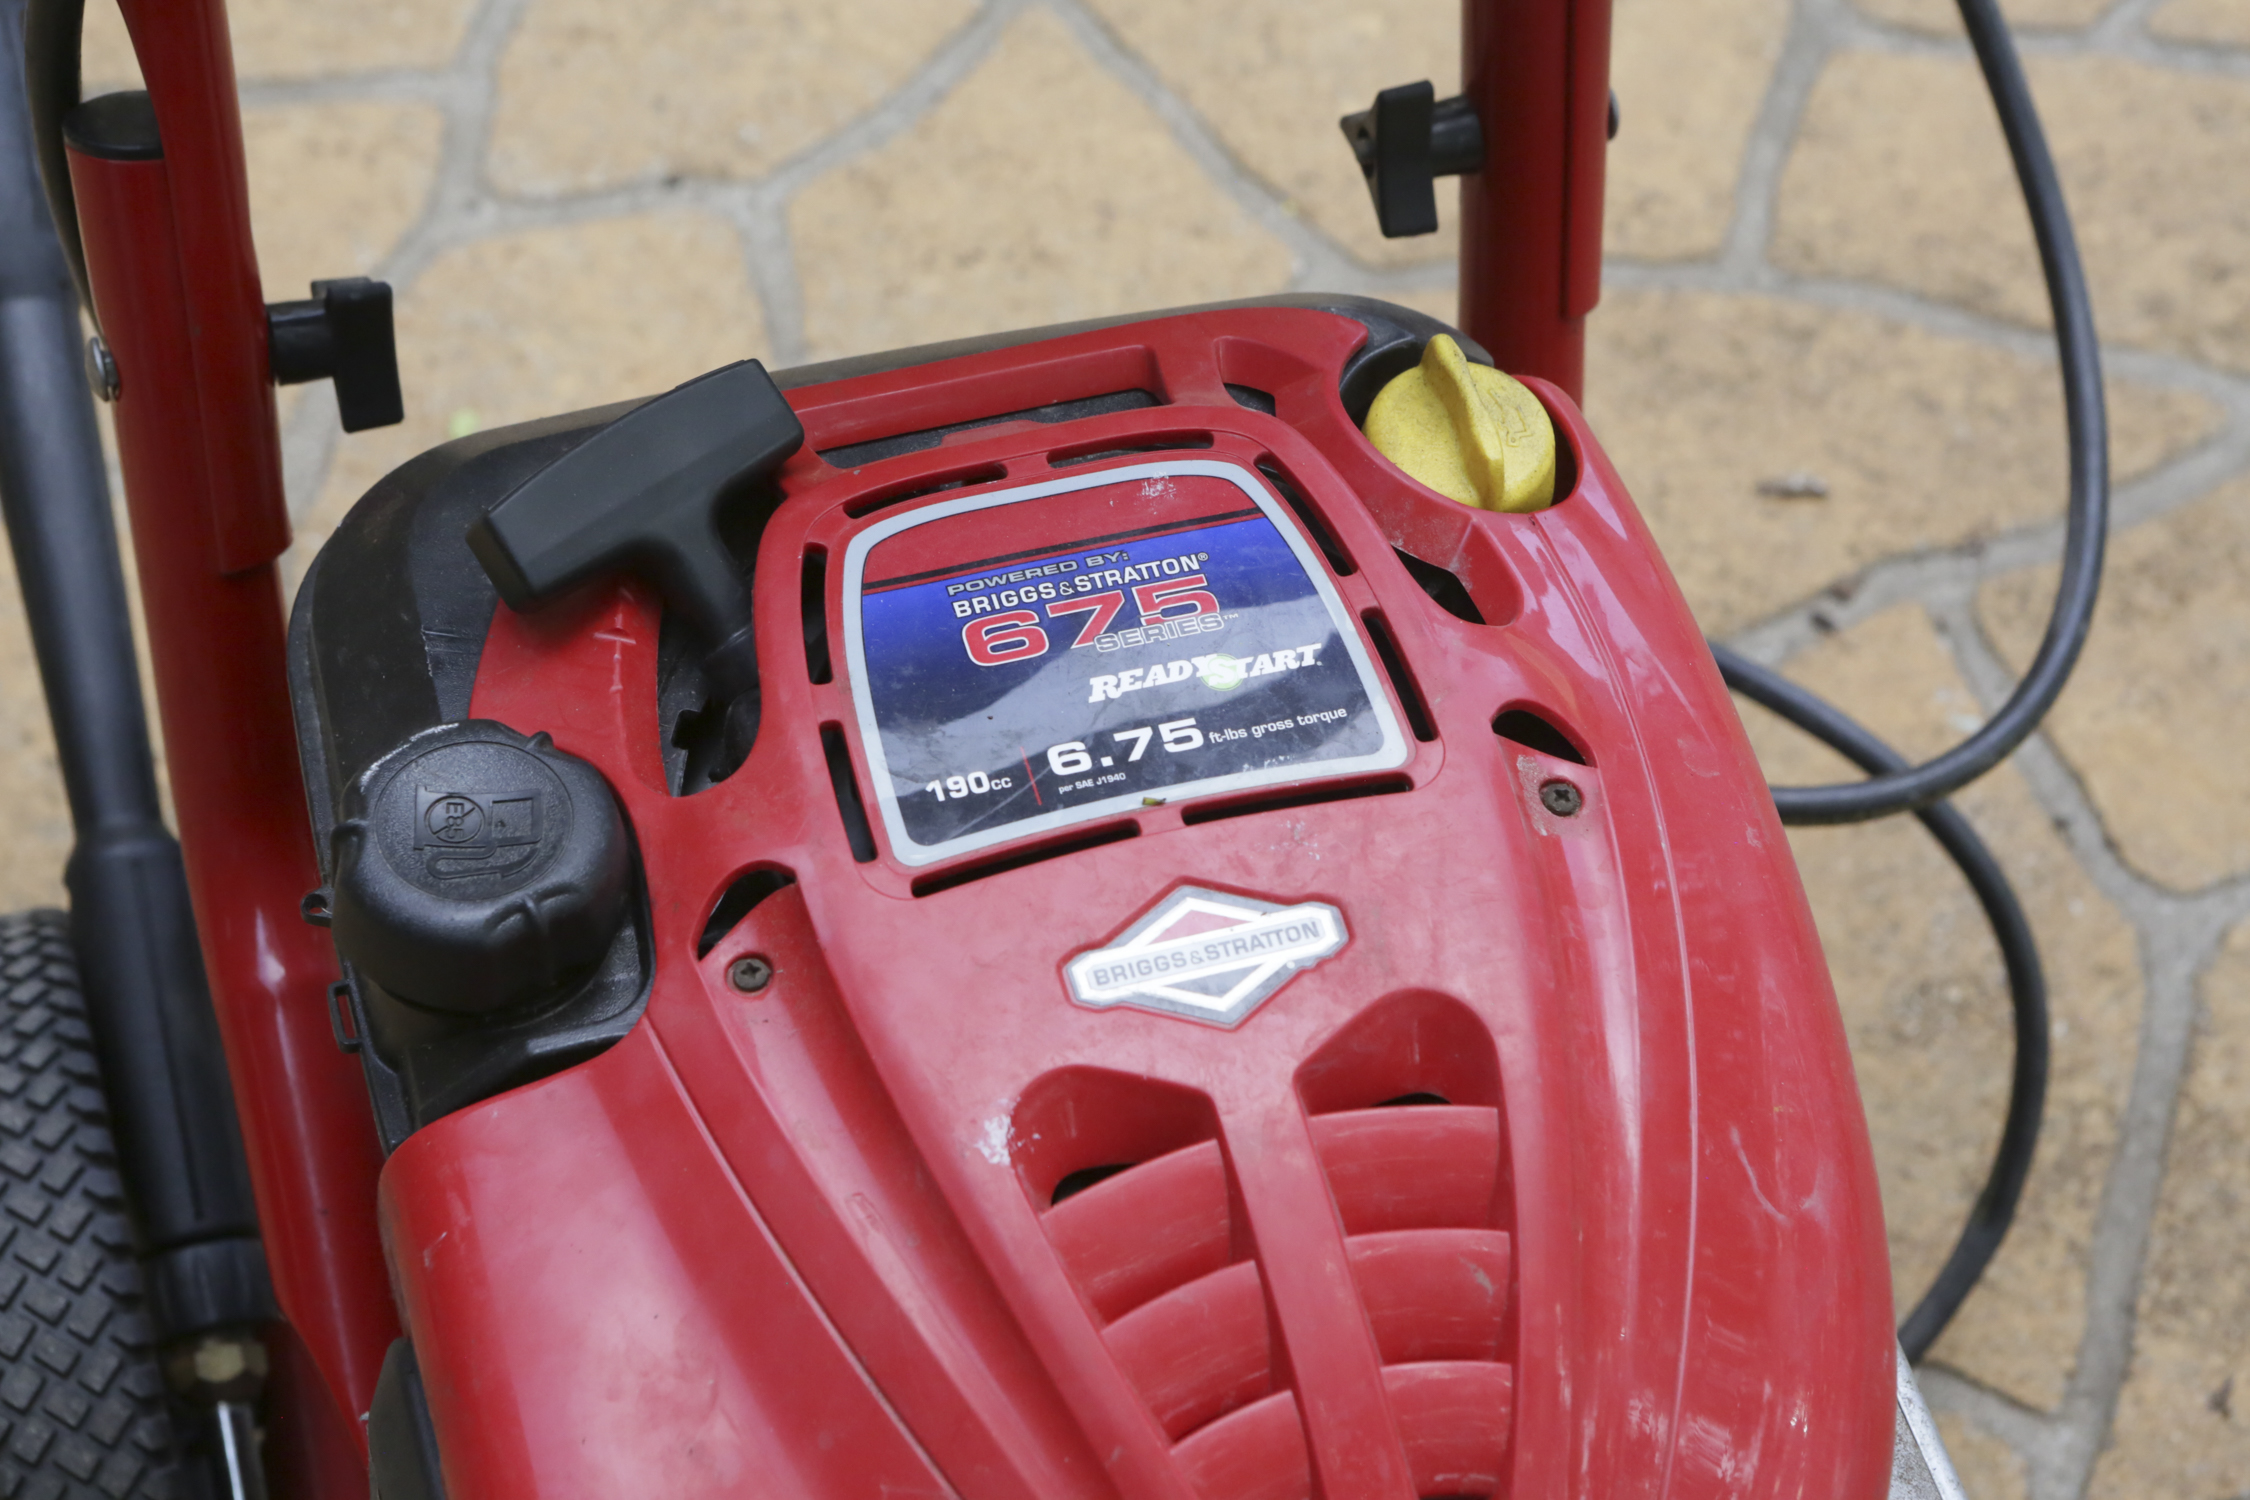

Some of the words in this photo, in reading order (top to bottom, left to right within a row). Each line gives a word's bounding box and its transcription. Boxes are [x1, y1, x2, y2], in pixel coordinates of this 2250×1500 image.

[947, 560, 1078, 596] POWERED
[1085, 550, 1130, 568] BY:
[962, 574, 1220, 667] 675
[1047, 717, 1204, 776] 6.75
[1208, 728, 1248, 744] ft-lbs
[1251, 718, 1294, 739] gross
[1297, 707, 1347, 727] torque
[1058, 783, 1074, 794] per
[1075, 778, 1094, 790] SAE
[1096, 772, 1126, 786] J1940
[445, 801, 465, 840] E85
